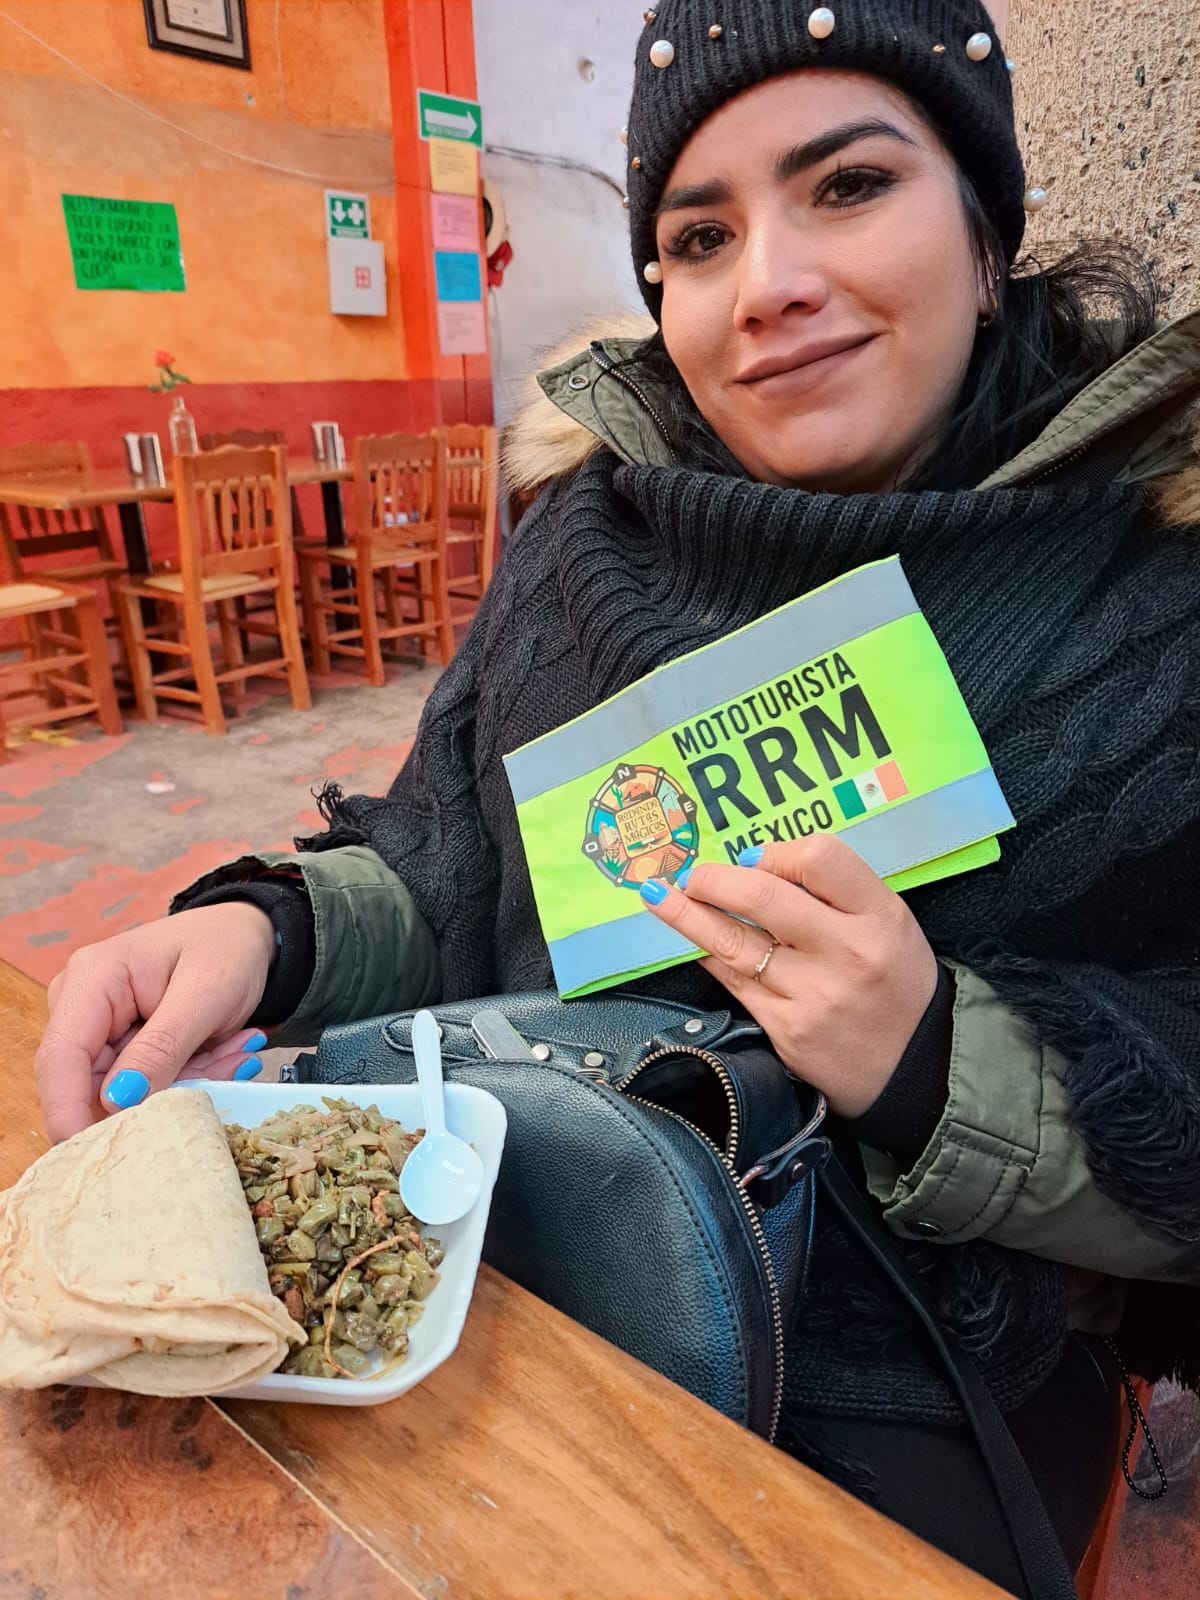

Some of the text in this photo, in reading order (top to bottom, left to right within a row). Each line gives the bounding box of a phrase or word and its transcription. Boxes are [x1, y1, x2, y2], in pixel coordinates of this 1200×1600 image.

[672, 652, 856, 761] MOTOTURISTA
[687, 683, 892, 832] RRM
[617, 766, 630, 779] N
[683, 801, 694, 812] E
[624, 810, 659, 832] RUTAS
